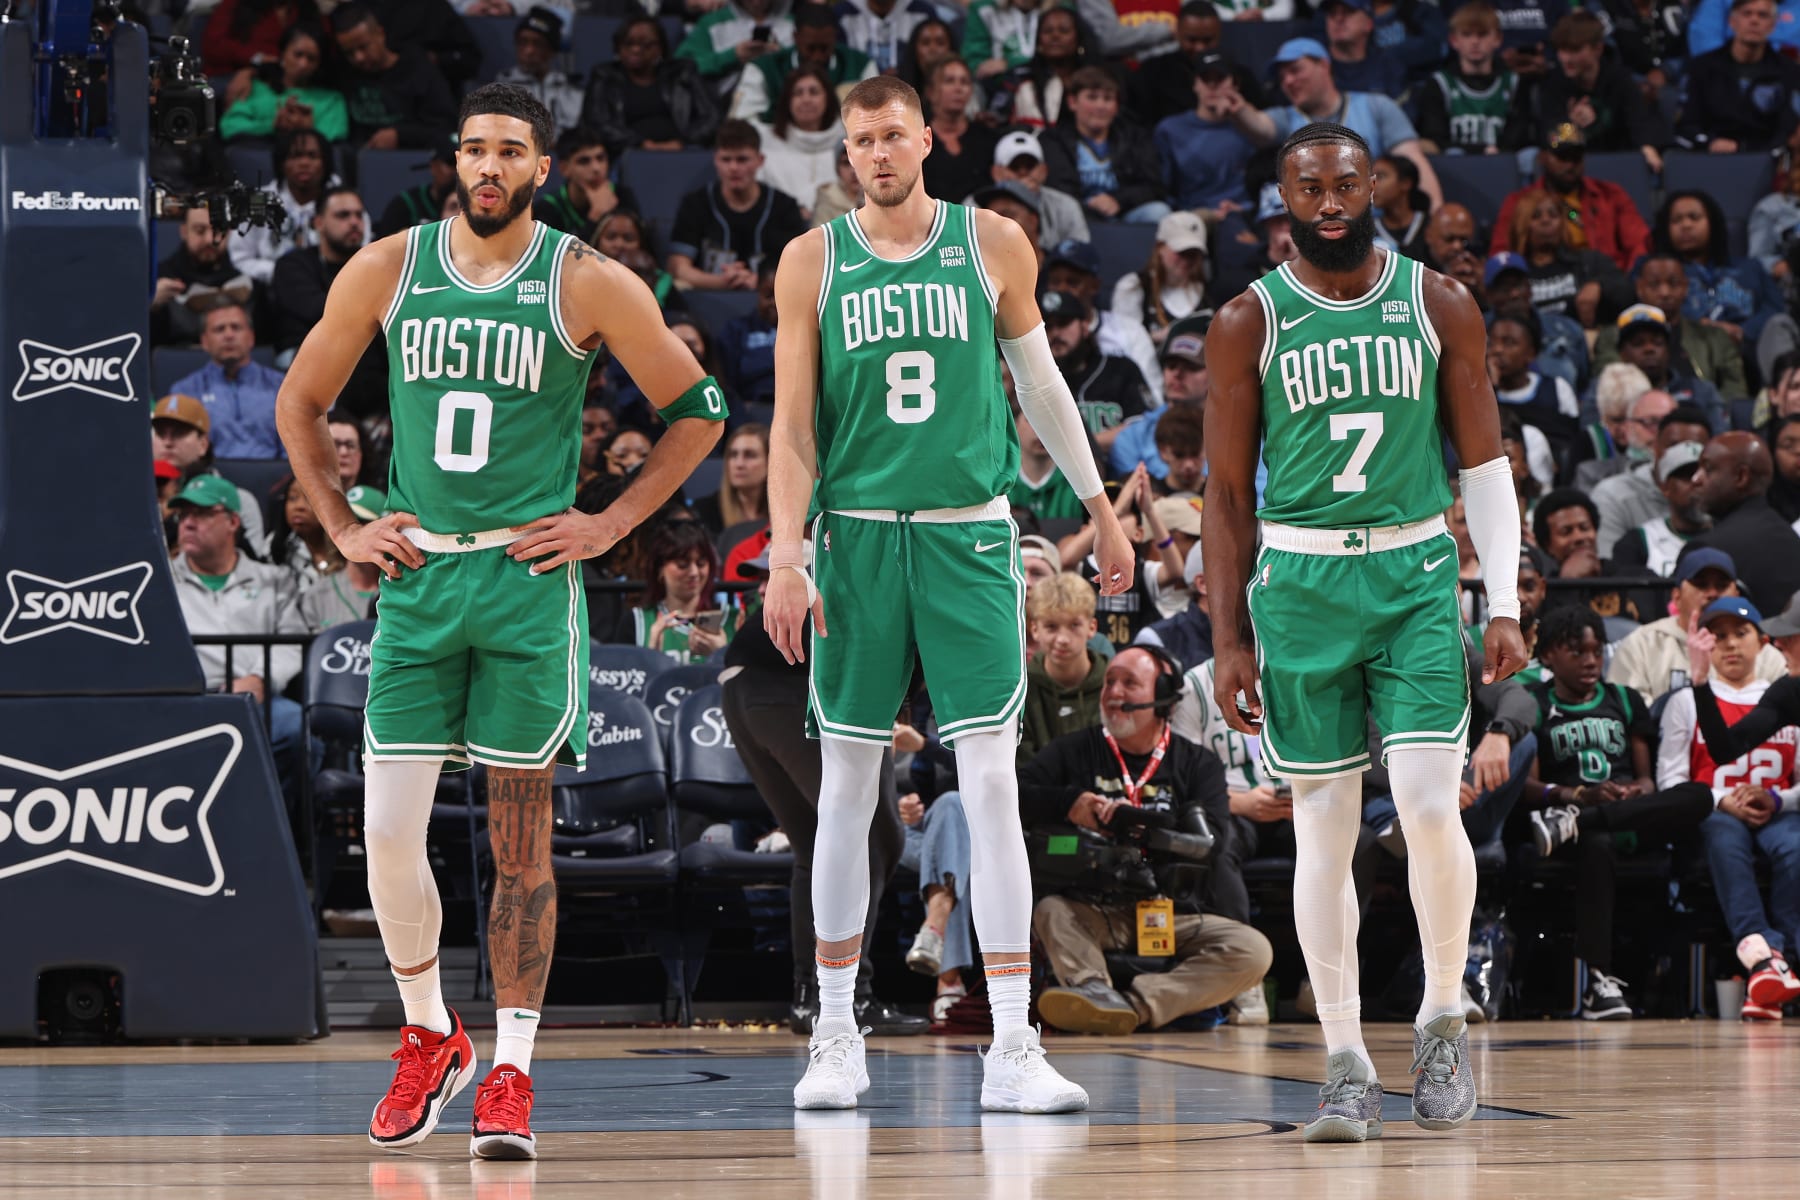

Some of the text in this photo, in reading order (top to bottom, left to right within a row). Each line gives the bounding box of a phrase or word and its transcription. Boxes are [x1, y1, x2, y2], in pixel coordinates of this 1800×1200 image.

[12, 191, 140, 210] FedExForum
[938, 245, 965, 259] VISTA
[940, 257, 966, 268] PRINT
[517, 280, 546, 294] VISTA
[517, 294, 546, 305] PRINT
[841, 283, 968, 351] BOSTON
[1381, 301, 1410, 313] VISTA
[1382, 313, 1410, 324] PRINT
[401, 317, 546, 393] BOSTON
[28, 357, 122, 381] SONIC
[1280, 335, 1423, 413] BOSTON
[703, 385, 721, 414] 0
[886, 351, 936, 423] 8
[434, 390, 493, 473] 0
[1329, 412, 1384, 492] 7
[18, 590, 130, 619] SONIC
[1107, 614, 1129, 644] 36
[588, 665, 646, 691] issy's
[588, 725, 643, 747] Cabin
